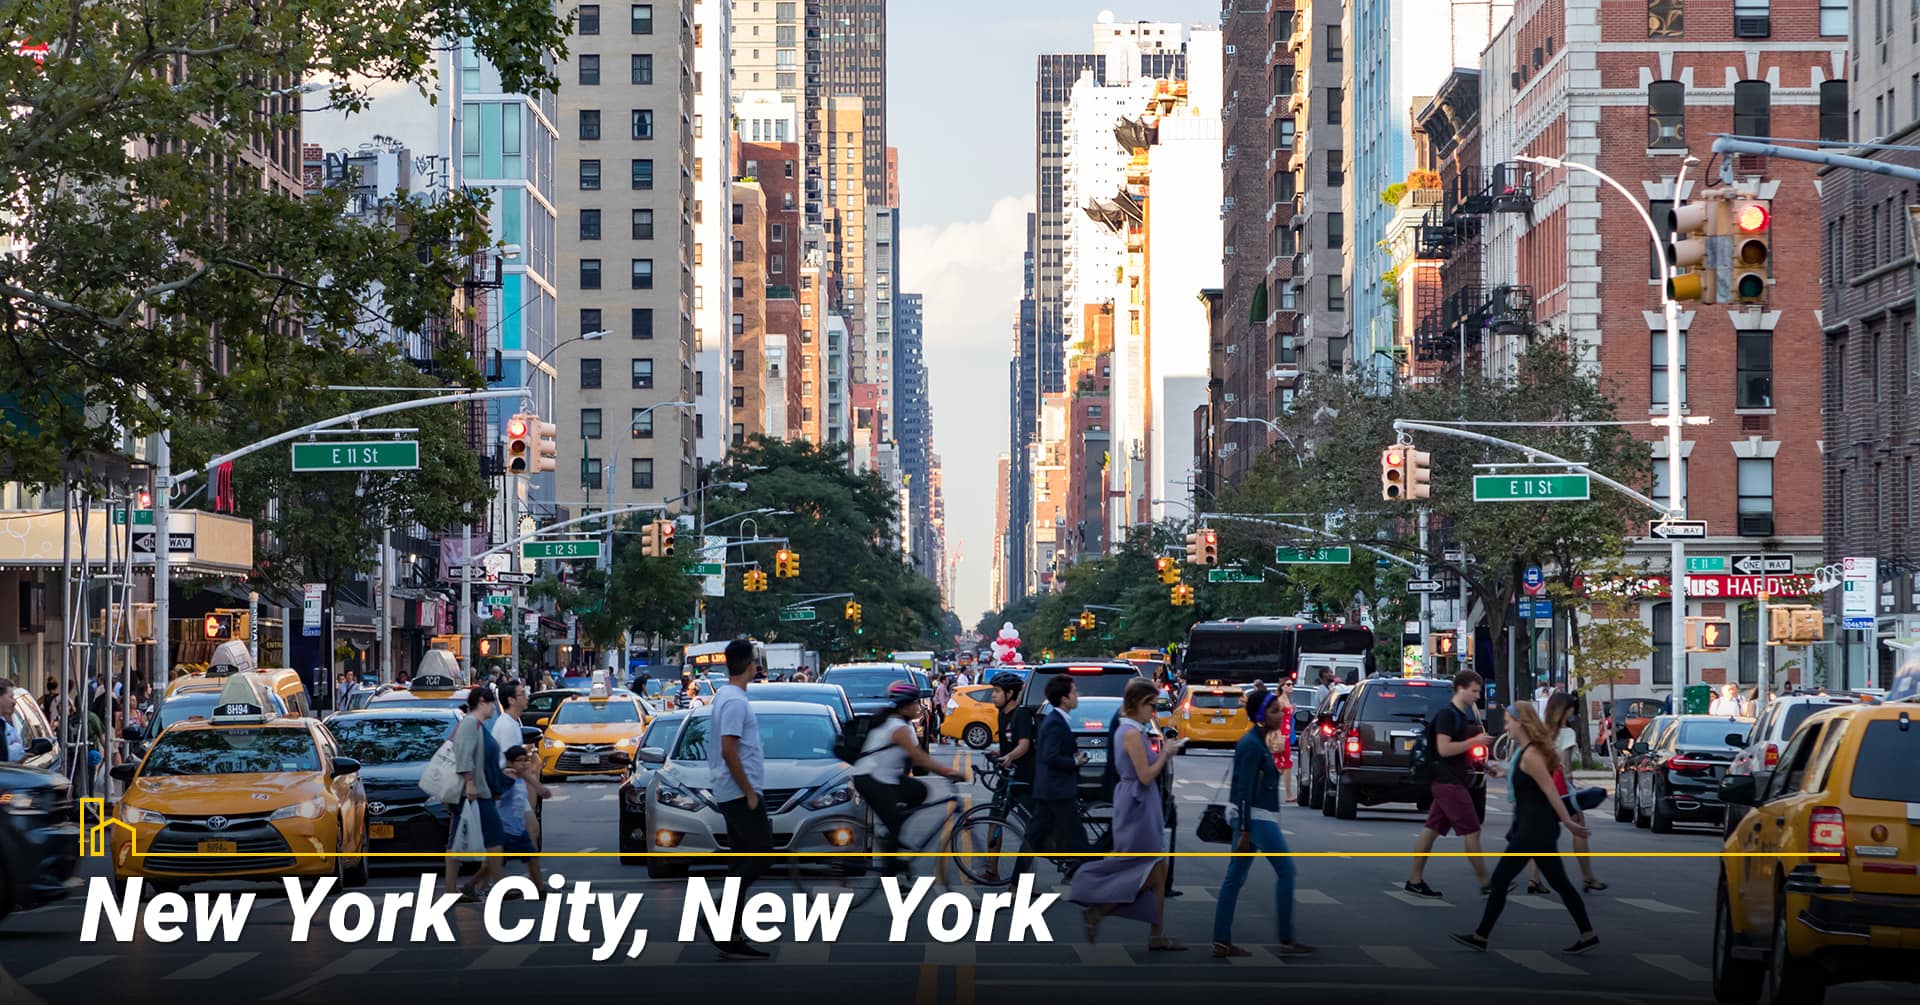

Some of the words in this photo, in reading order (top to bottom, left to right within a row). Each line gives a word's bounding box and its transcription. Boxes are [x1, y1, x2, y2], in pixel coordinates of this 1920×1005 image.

[333, 448, 341, 463] E
[348, 448, 356, 463] 11
[363, 448, 378, 463] St
[1511, 481, 1518, 494] E
[1525, 481, 1532, 494] 11
[1539, 480, 1552, 494] St
[118, 511, 124, 523] E
[169, 538, 188, 548] WAY
[546, 545, 551, 555] E
[555, 545, 564, 555] 12
[567, 545, 577, 554] St
[1319, 550, 1328, 560] St
[1692, 559, 1697, 569] E
[1702, 558, 1708, 568] 11
[1743, 561, 1760, 569] ONE
[1769, 560, 1787, 568] WAY
[227, 704, 248, 715] 8H94
